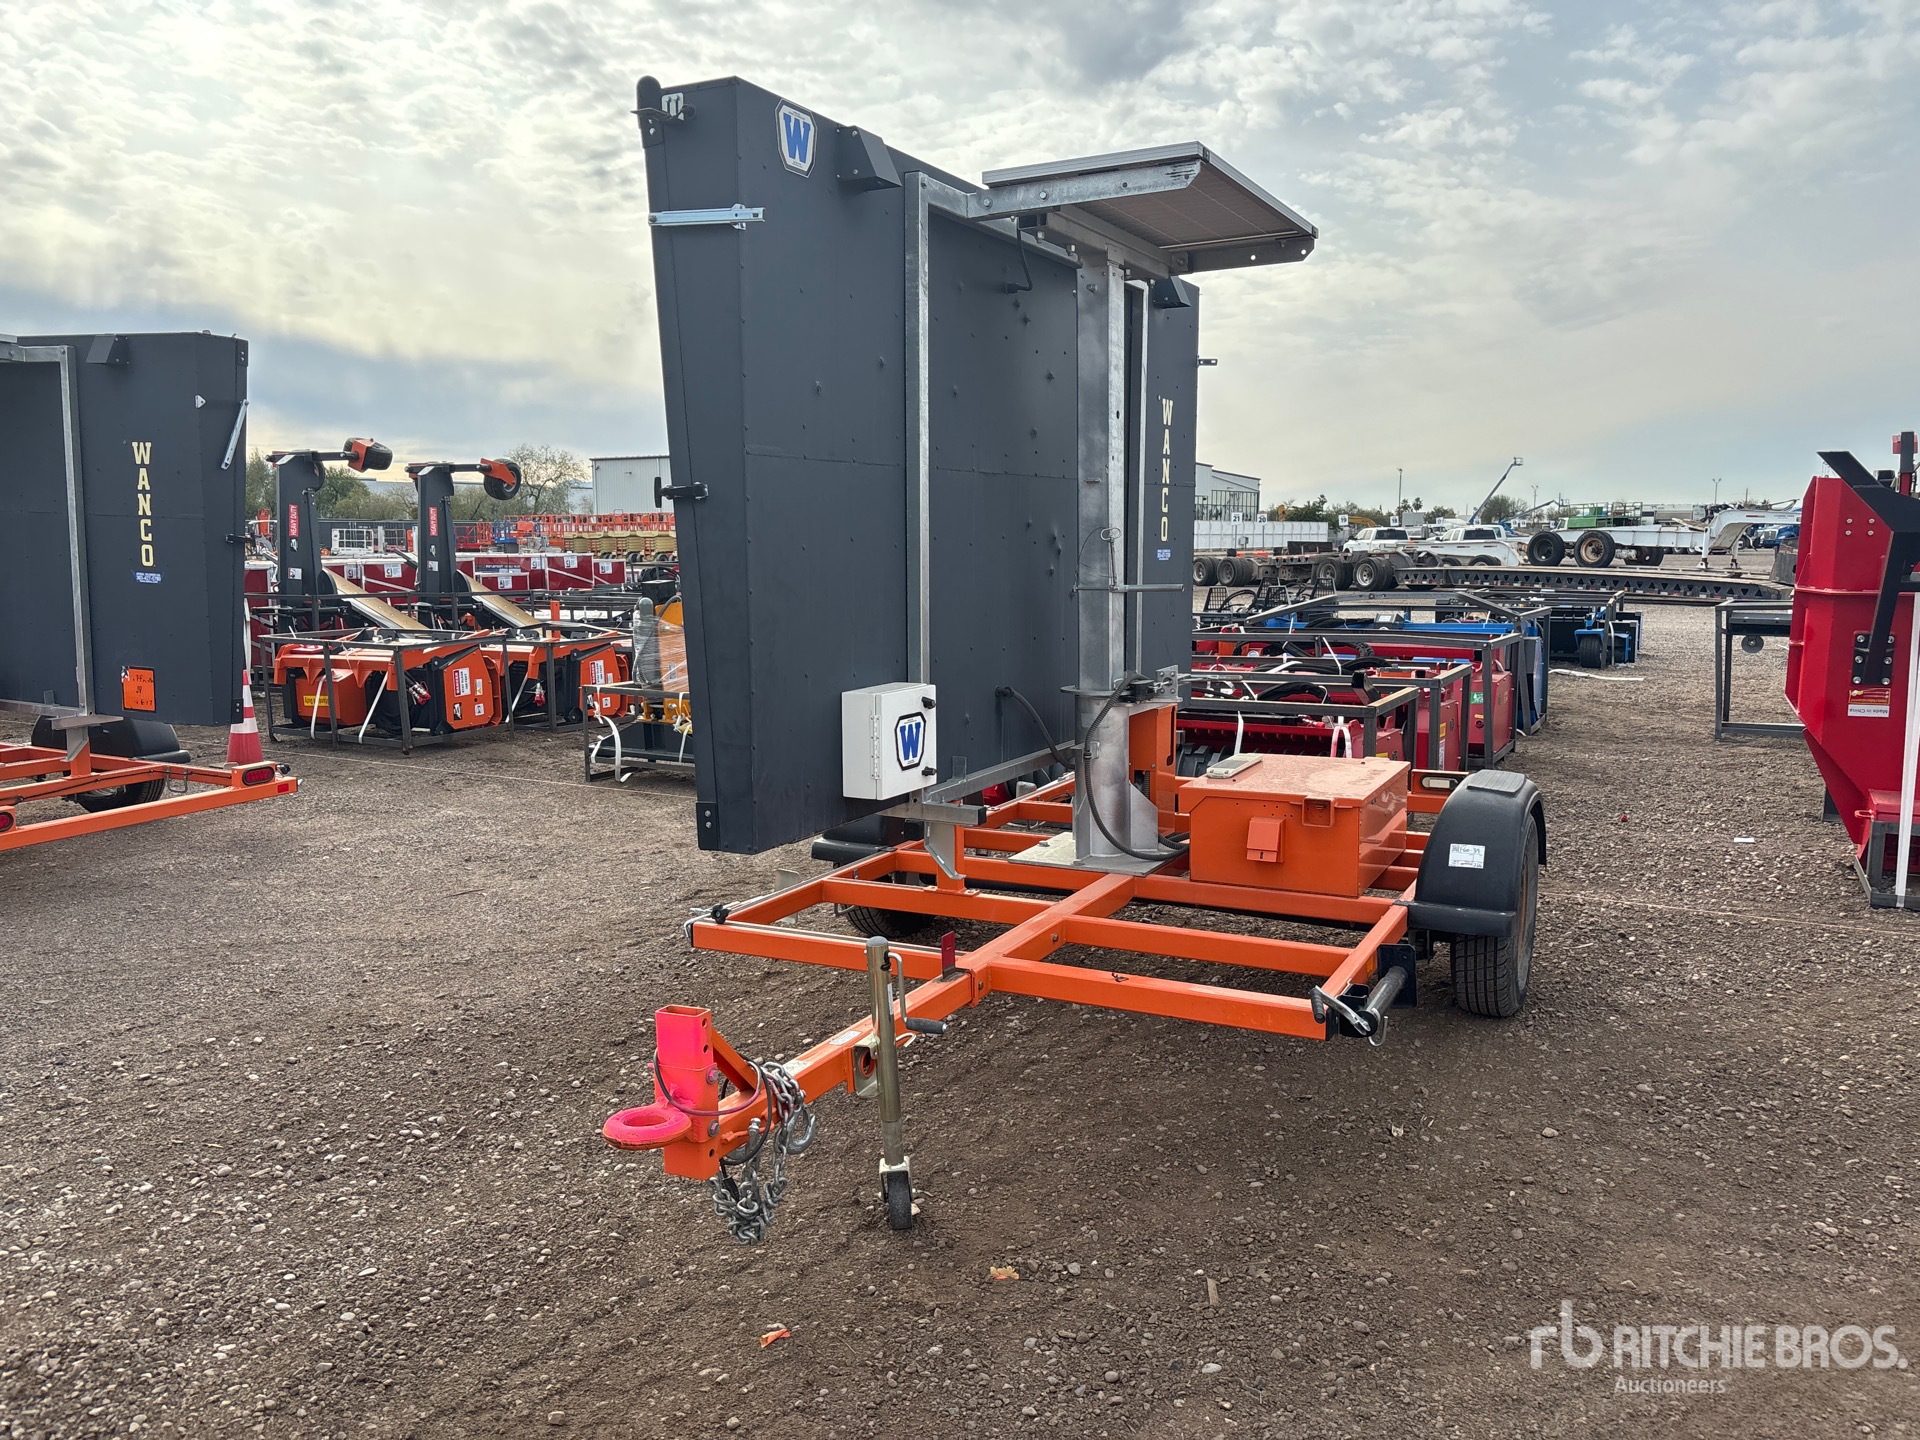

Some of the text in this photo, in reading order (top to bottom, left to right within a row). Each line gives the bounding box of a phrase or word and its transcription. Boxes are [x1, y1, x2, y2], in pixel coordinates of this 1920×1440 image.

[783, 112, 811, 164] W
[131, 441, 154, 567] WANCO
[1160, 398, 1174, 542] WANCO
[899, 721, 921, 760] W
